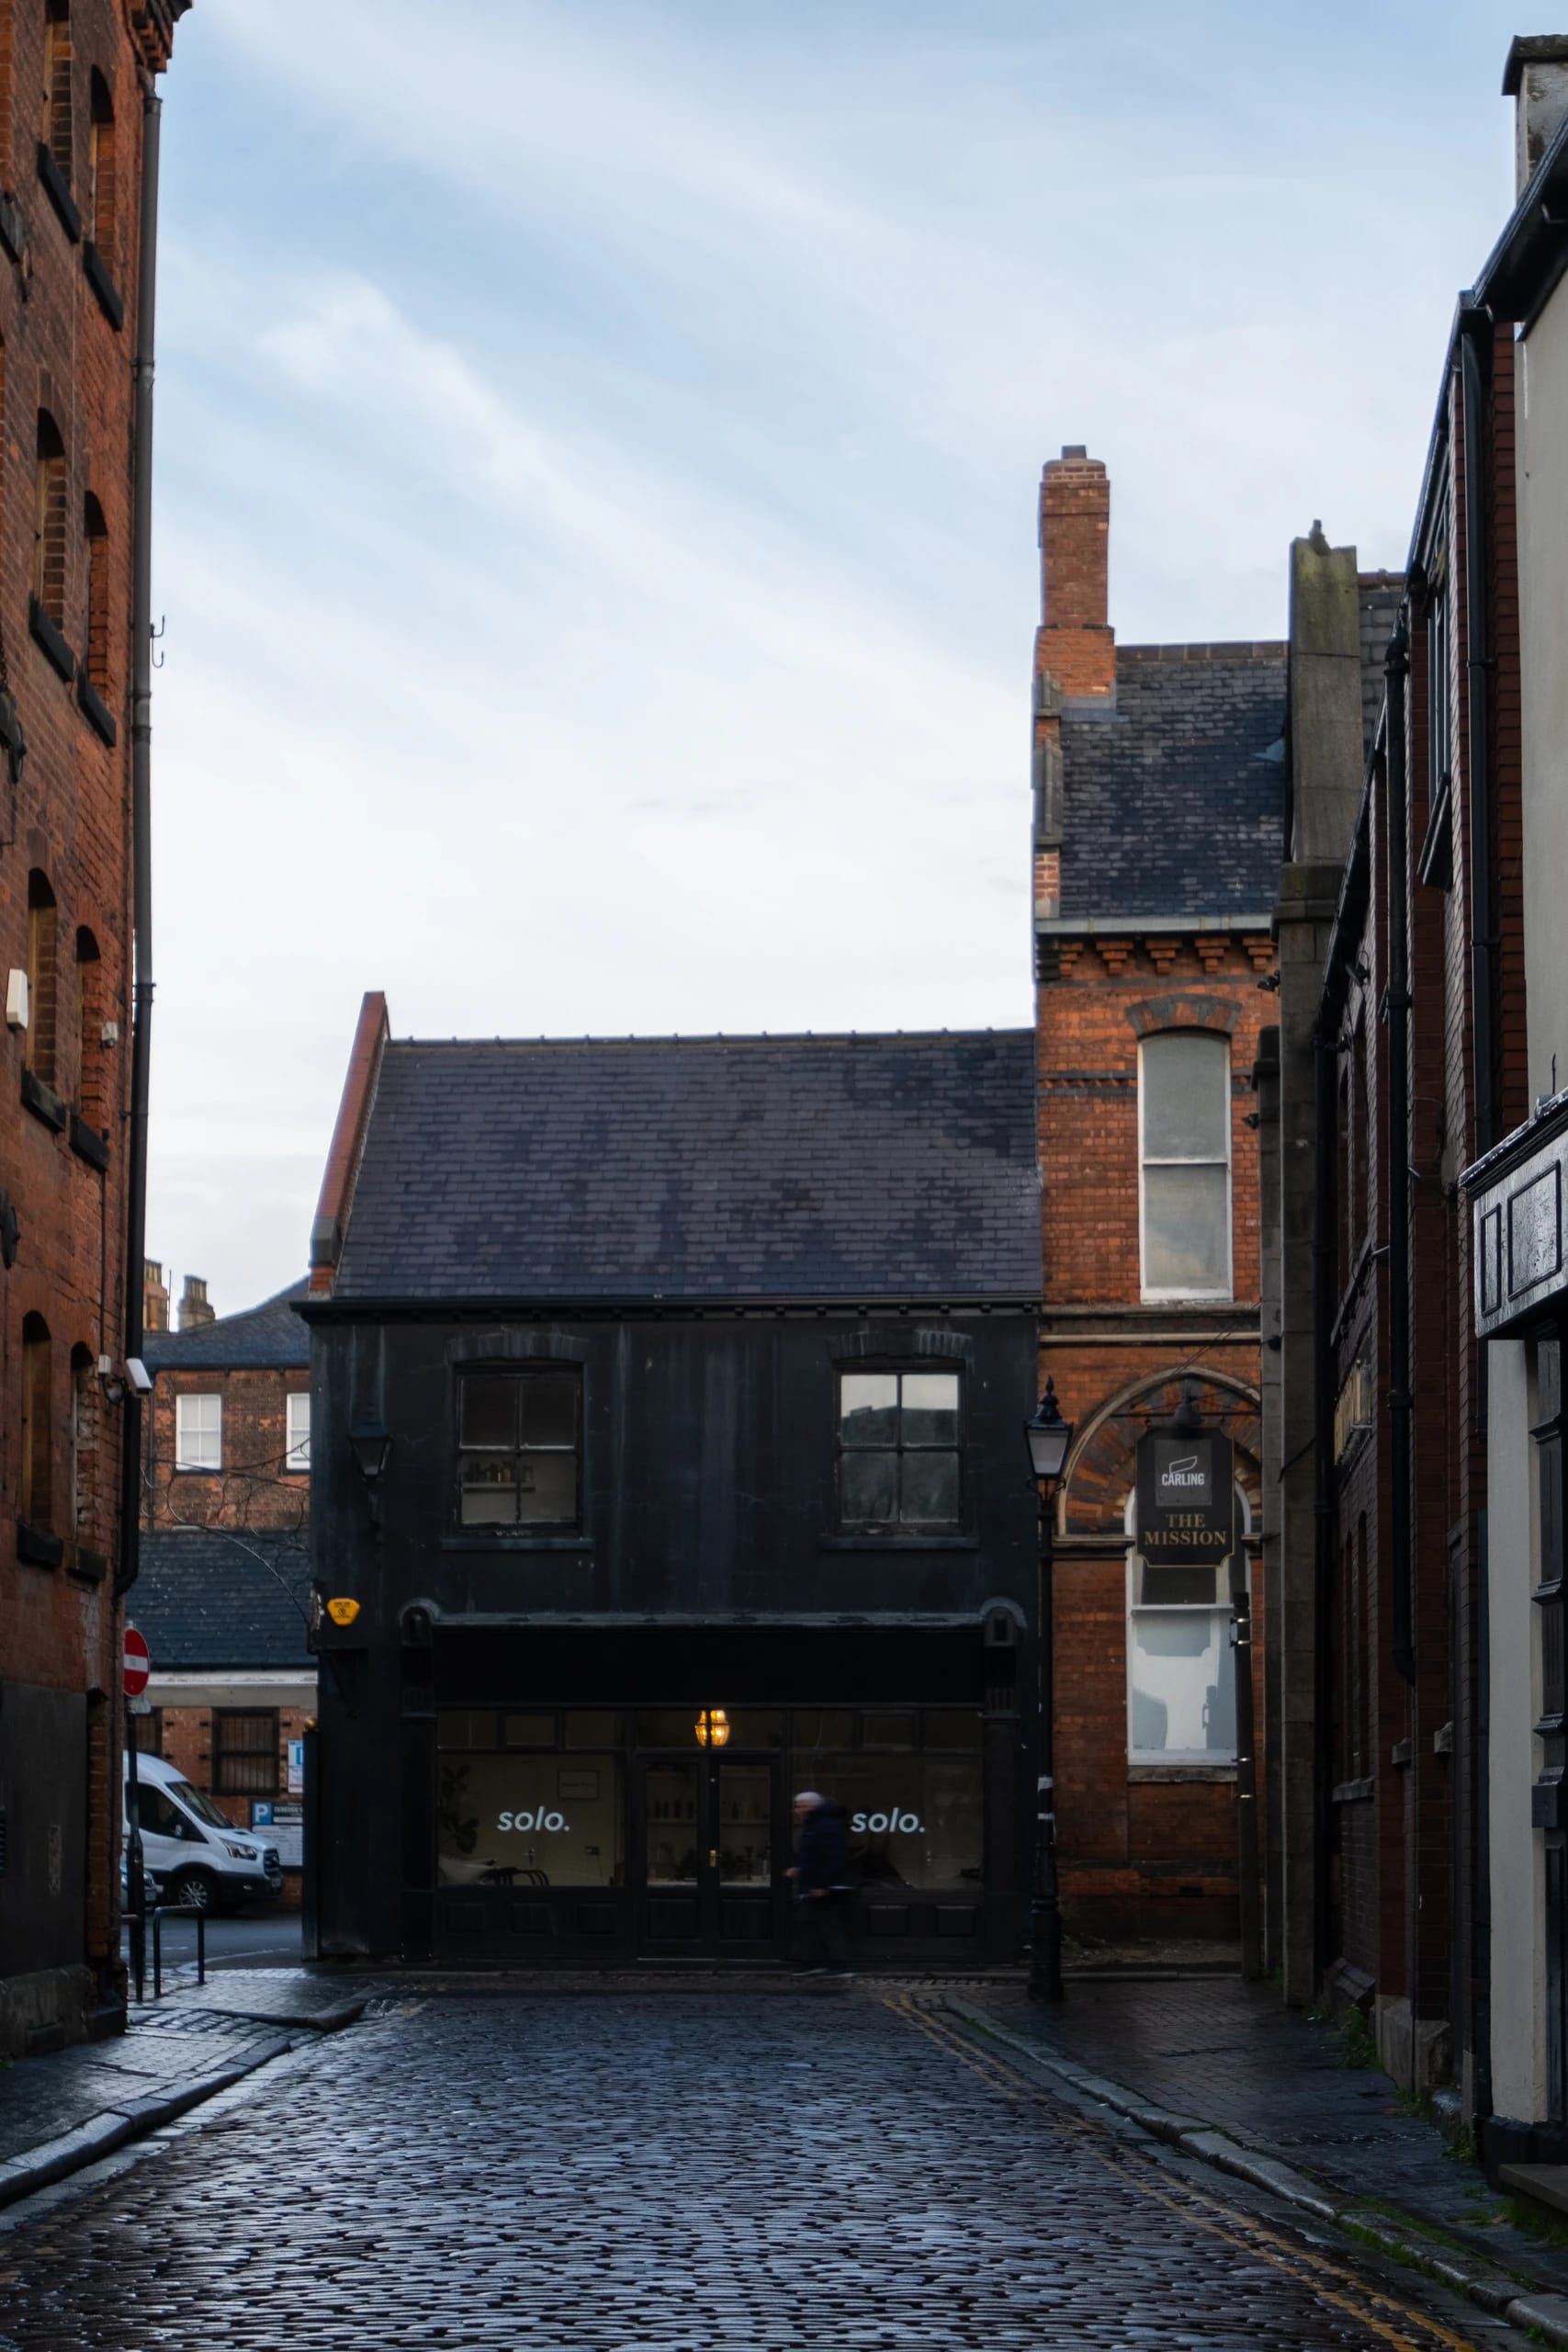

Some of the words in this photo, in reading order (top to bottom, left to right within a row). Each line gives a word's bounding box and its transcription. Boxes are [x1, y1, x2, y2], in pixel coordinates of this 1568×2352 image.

[1161, 1473, 1205, 1486] CARLING
[1165, 1513, 1206, 1528] THE
[1144, 1531, 1227, 1544] MISSION
[254, 1804, 268, 1823] P
[497, 1805, 570, 1831] solo.
[851, 1807, 926, 1833] solo.
